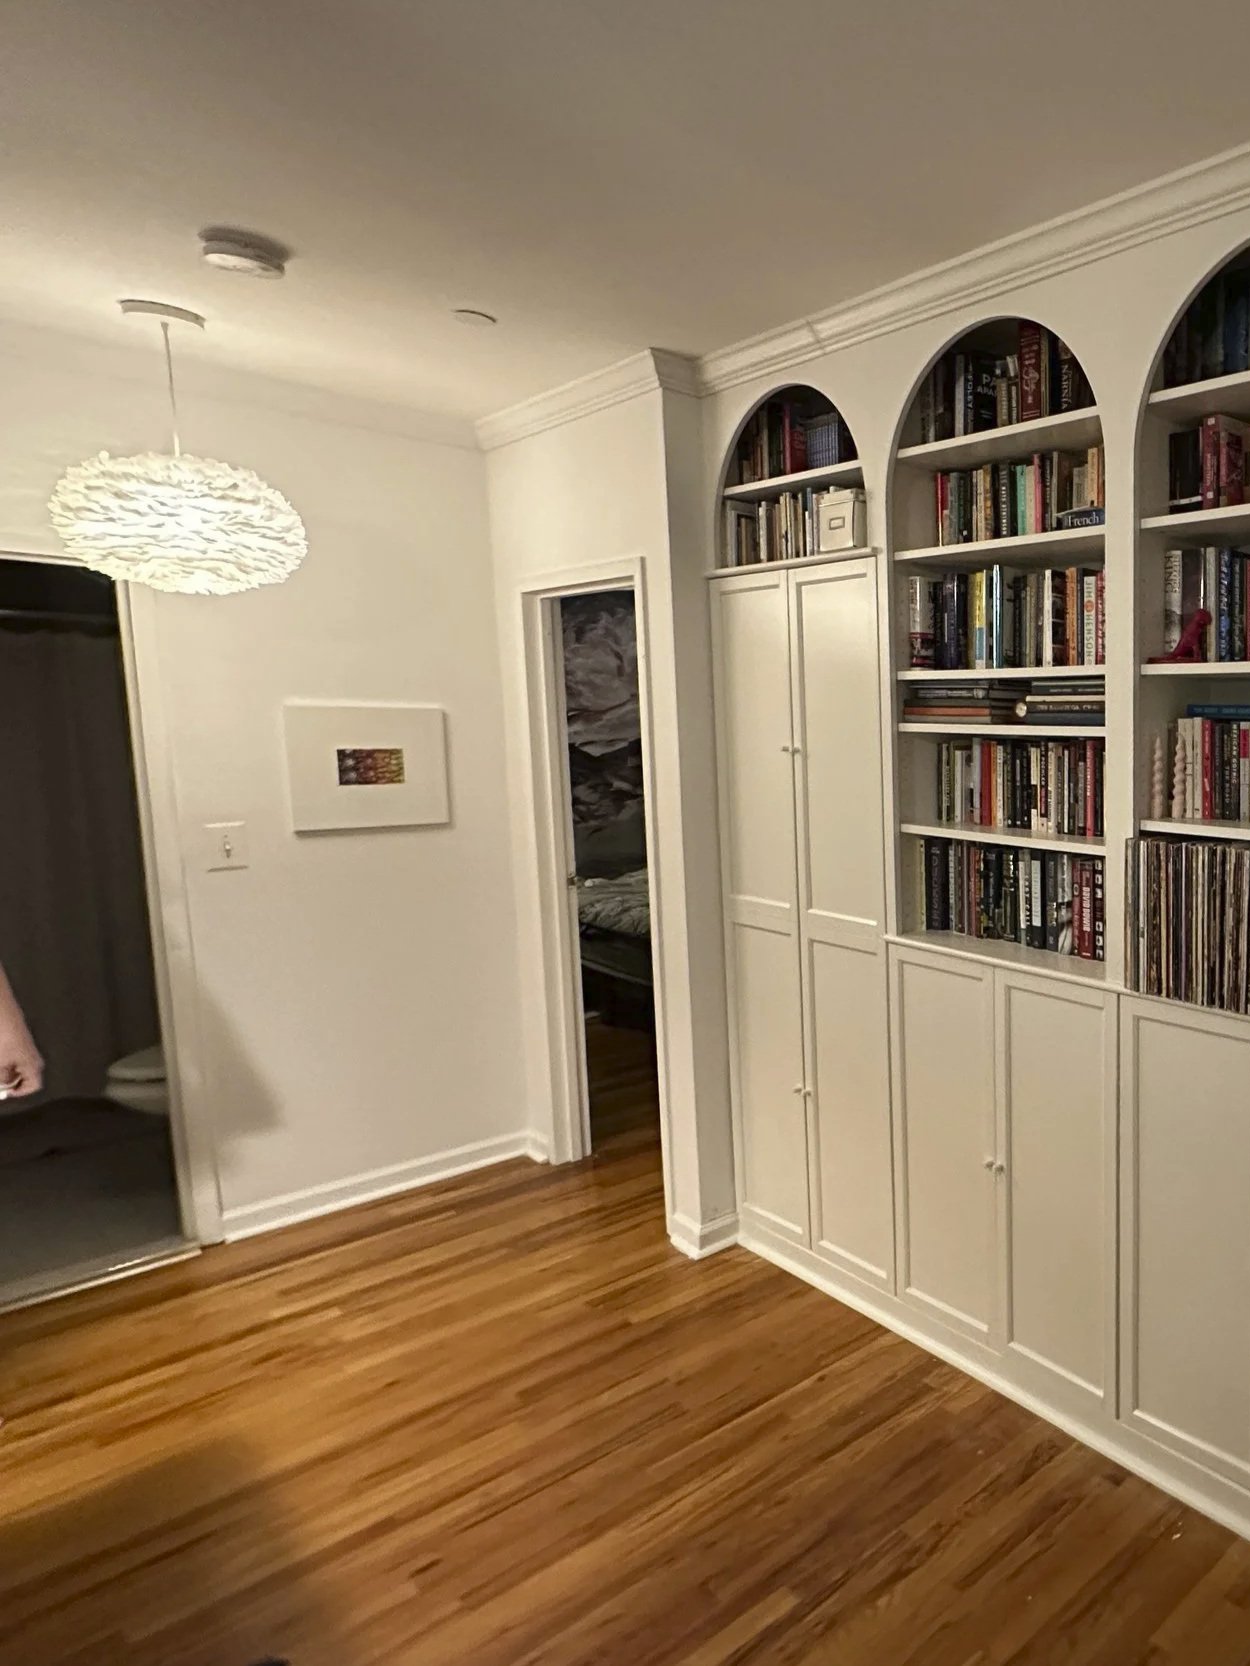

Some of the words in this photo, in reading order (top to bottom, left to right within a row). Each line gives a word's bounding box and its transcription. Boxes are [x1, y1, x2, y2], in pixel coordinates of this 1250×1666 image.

[1061, 364, 1069, 410] NARNIA
[1067, 512, 1100, 527] French
[1165, 555, 1173, 593] KING
[1083, 908, 1091, 932] BOWIE
